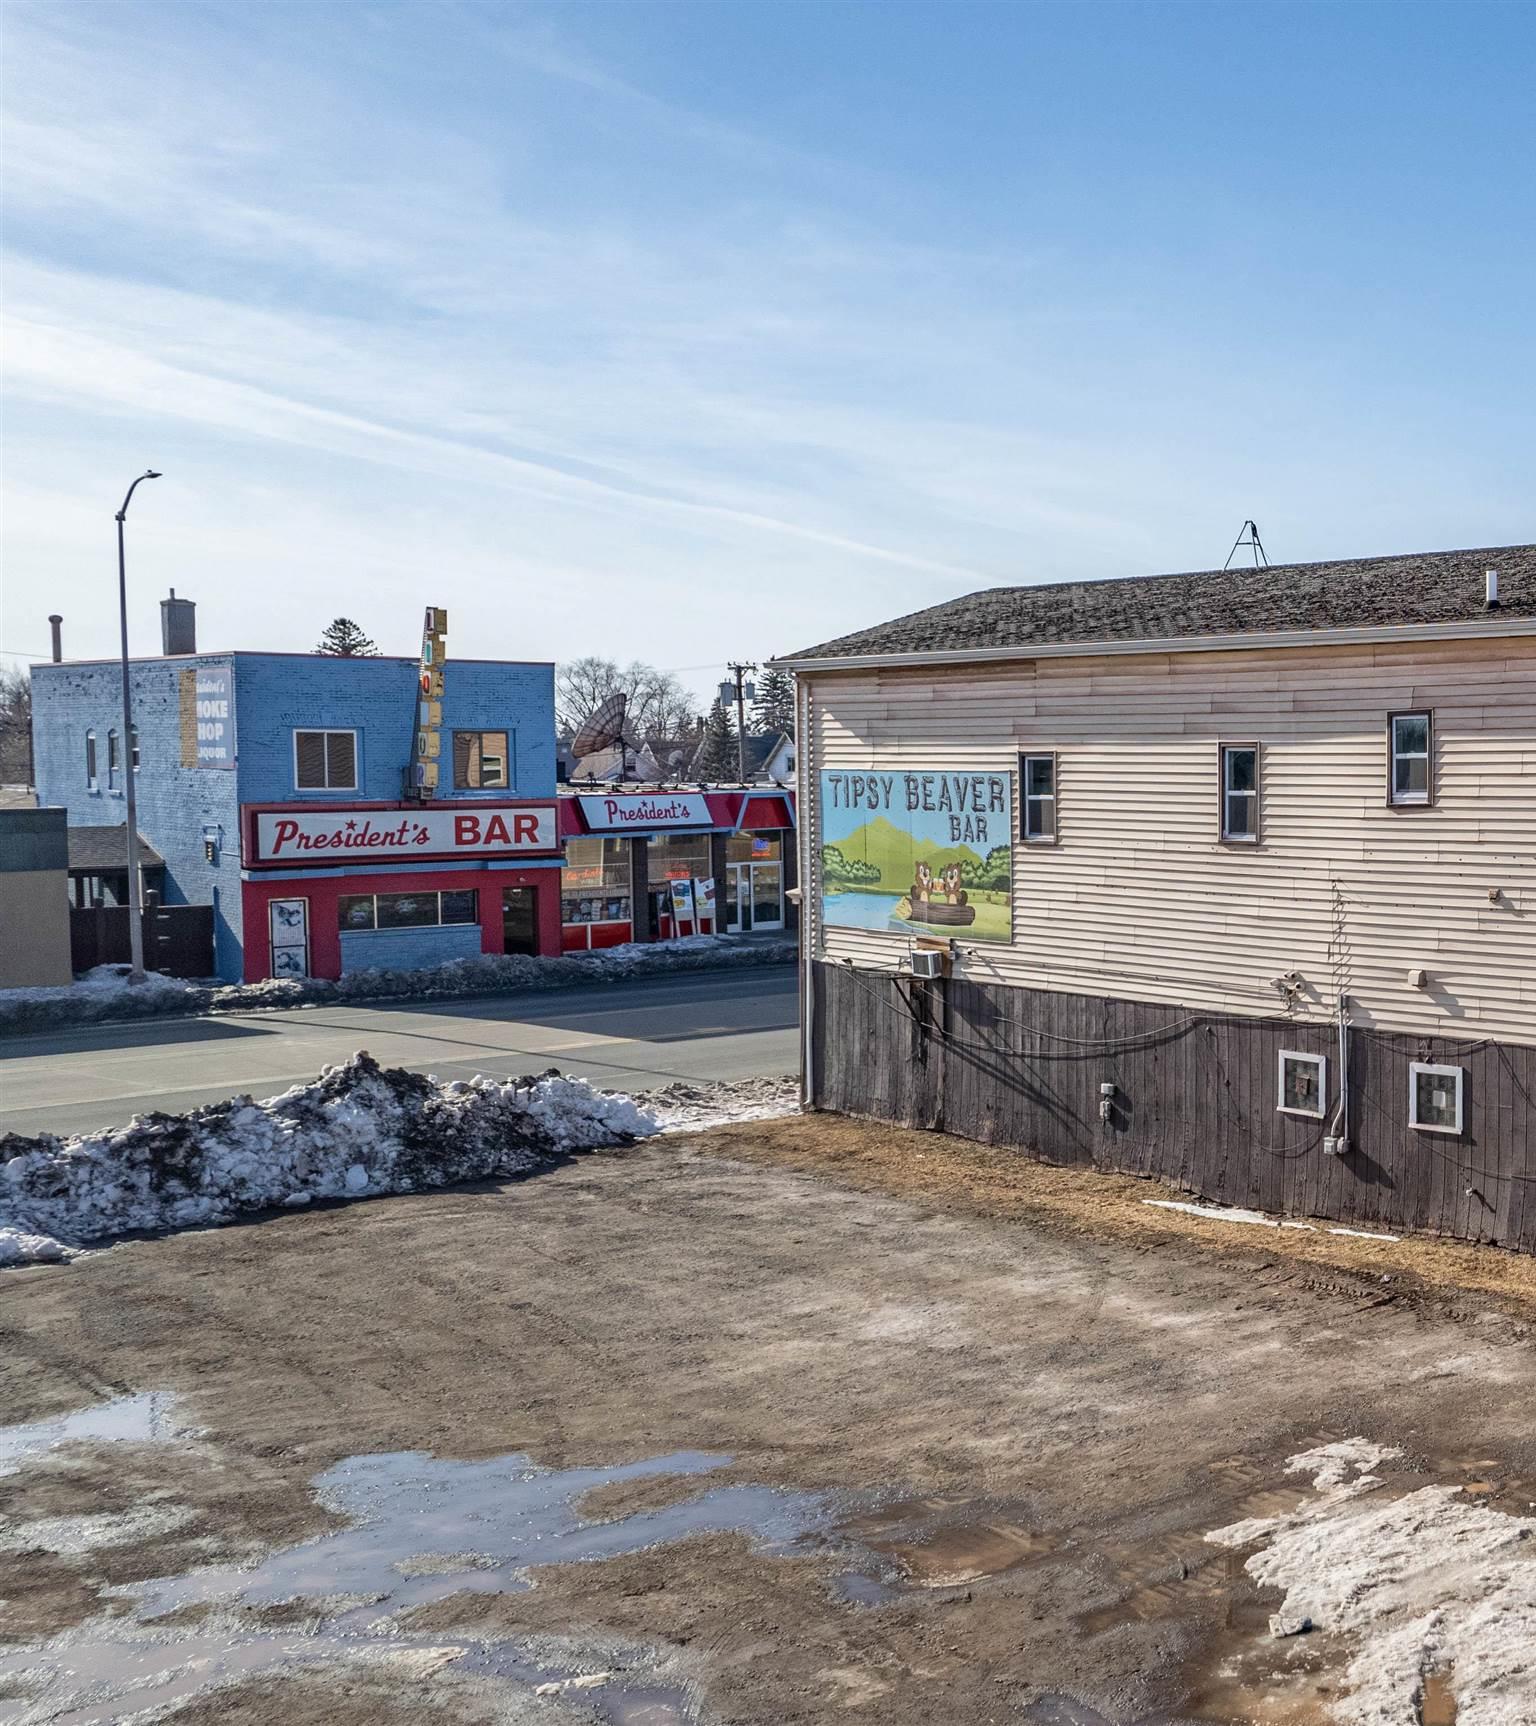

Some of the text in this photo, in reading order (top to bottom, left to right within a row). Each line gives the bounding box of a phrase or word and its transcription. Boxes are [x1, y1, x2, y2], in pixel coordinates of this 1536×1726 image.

[828, 774, 1005, 813] TIPSY BEAVER
[604, 799, 691, 824] President's
[949, 814, 988, 843] BAR
[271, 813, 540, 855] President's BAR
